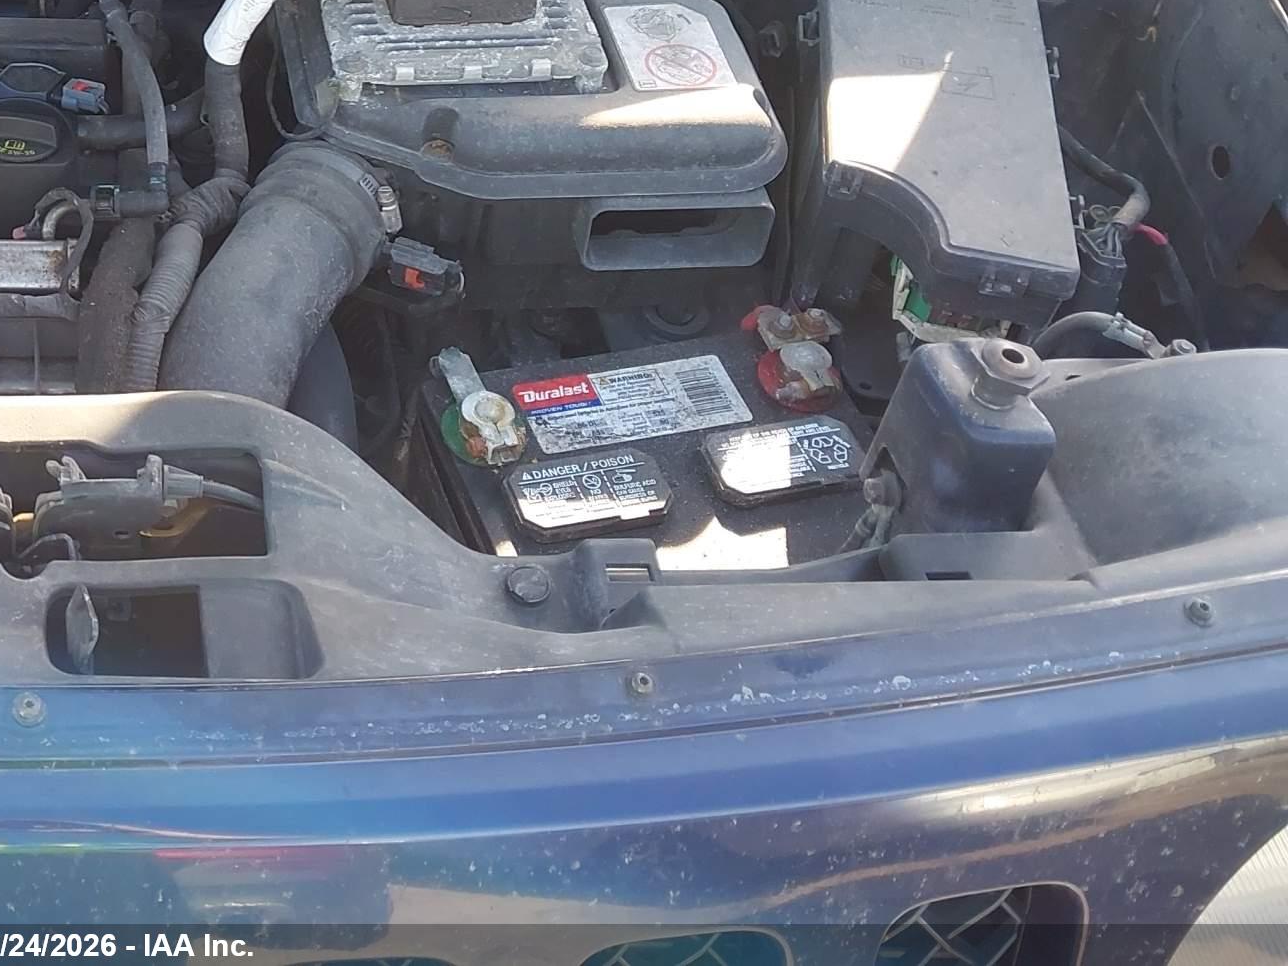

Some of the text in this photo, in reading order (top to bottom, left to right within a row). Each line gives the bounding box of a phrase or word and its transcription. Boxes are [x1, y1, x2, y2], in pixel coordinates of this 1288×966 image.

[518, 382, 589, 403] Duralast
[532, 455, 634, 480] DANGER / POISON
